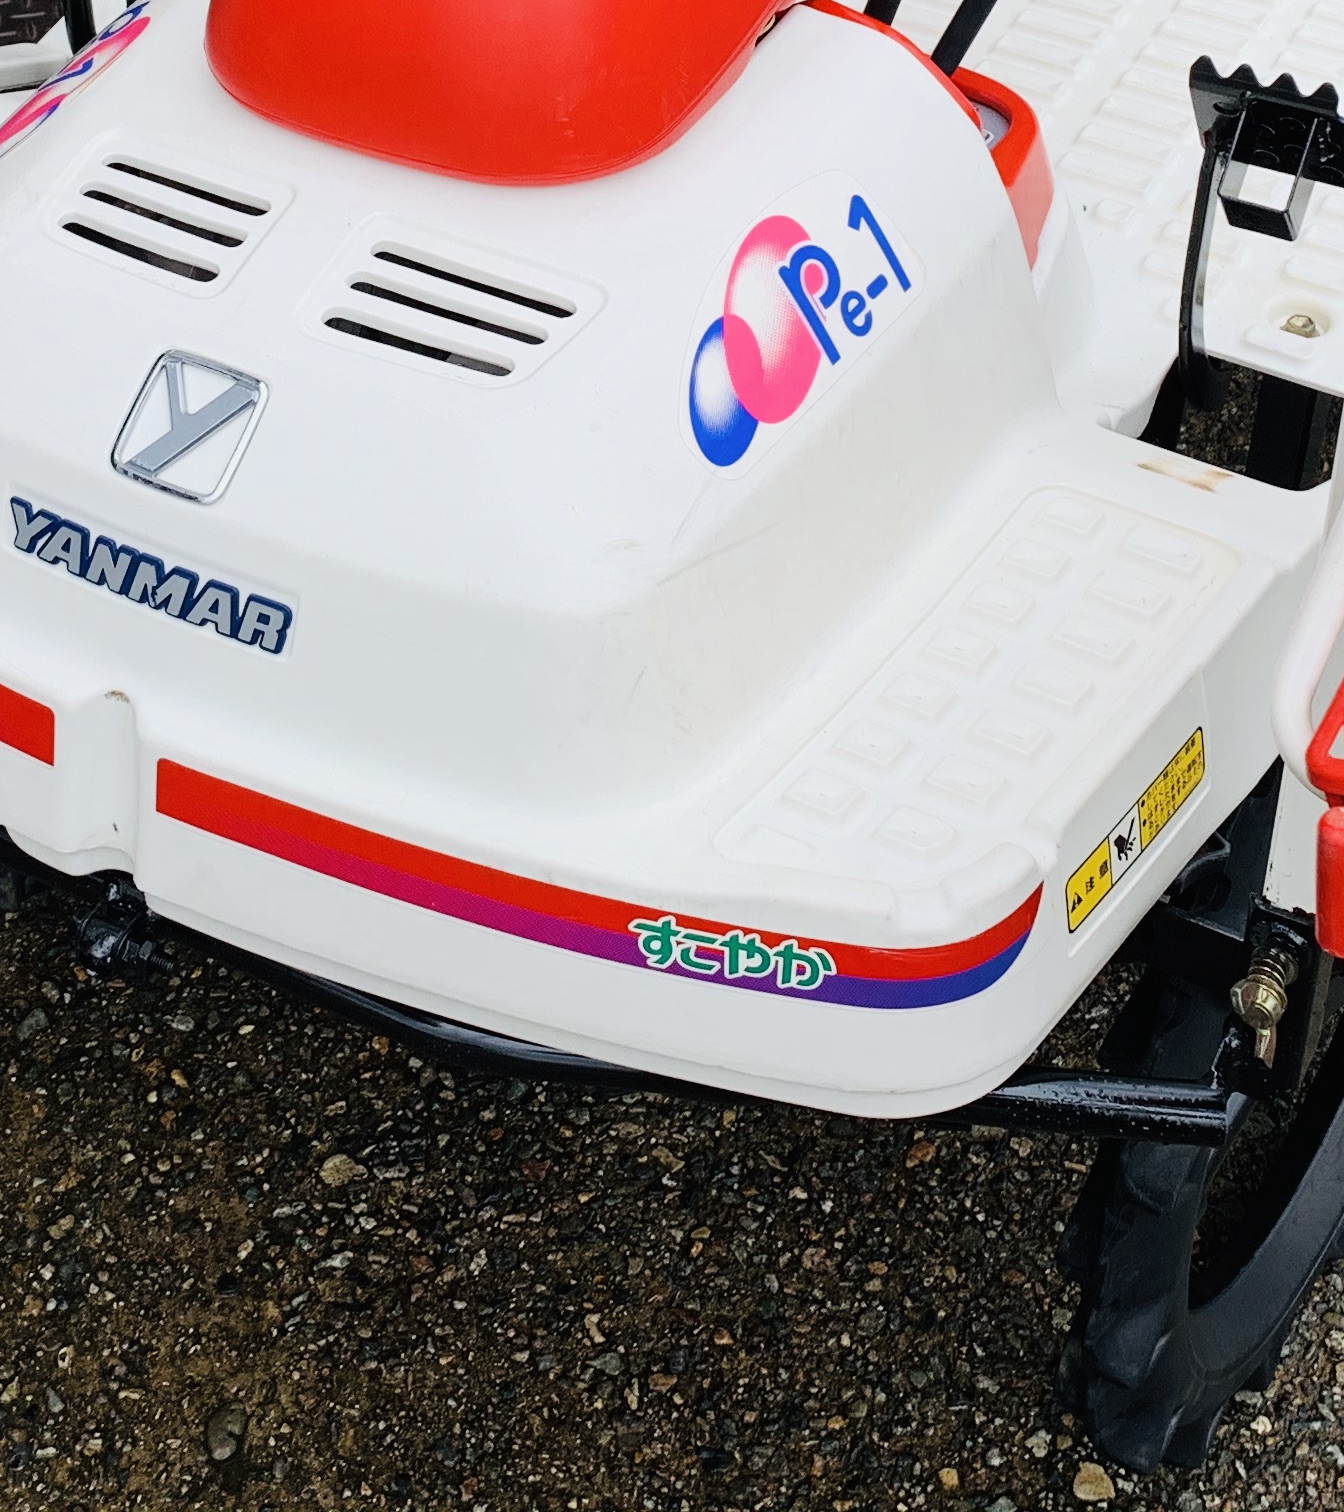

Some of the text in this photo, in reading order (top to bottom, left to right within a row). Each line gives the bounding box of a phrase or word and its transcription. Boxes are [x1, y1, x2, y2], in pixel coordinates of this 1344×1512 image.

[9, 495, 293, 655] YANMAR
[1085, 858, 1109, 896] 注意
[630, 917, 835, 989] すこやか
